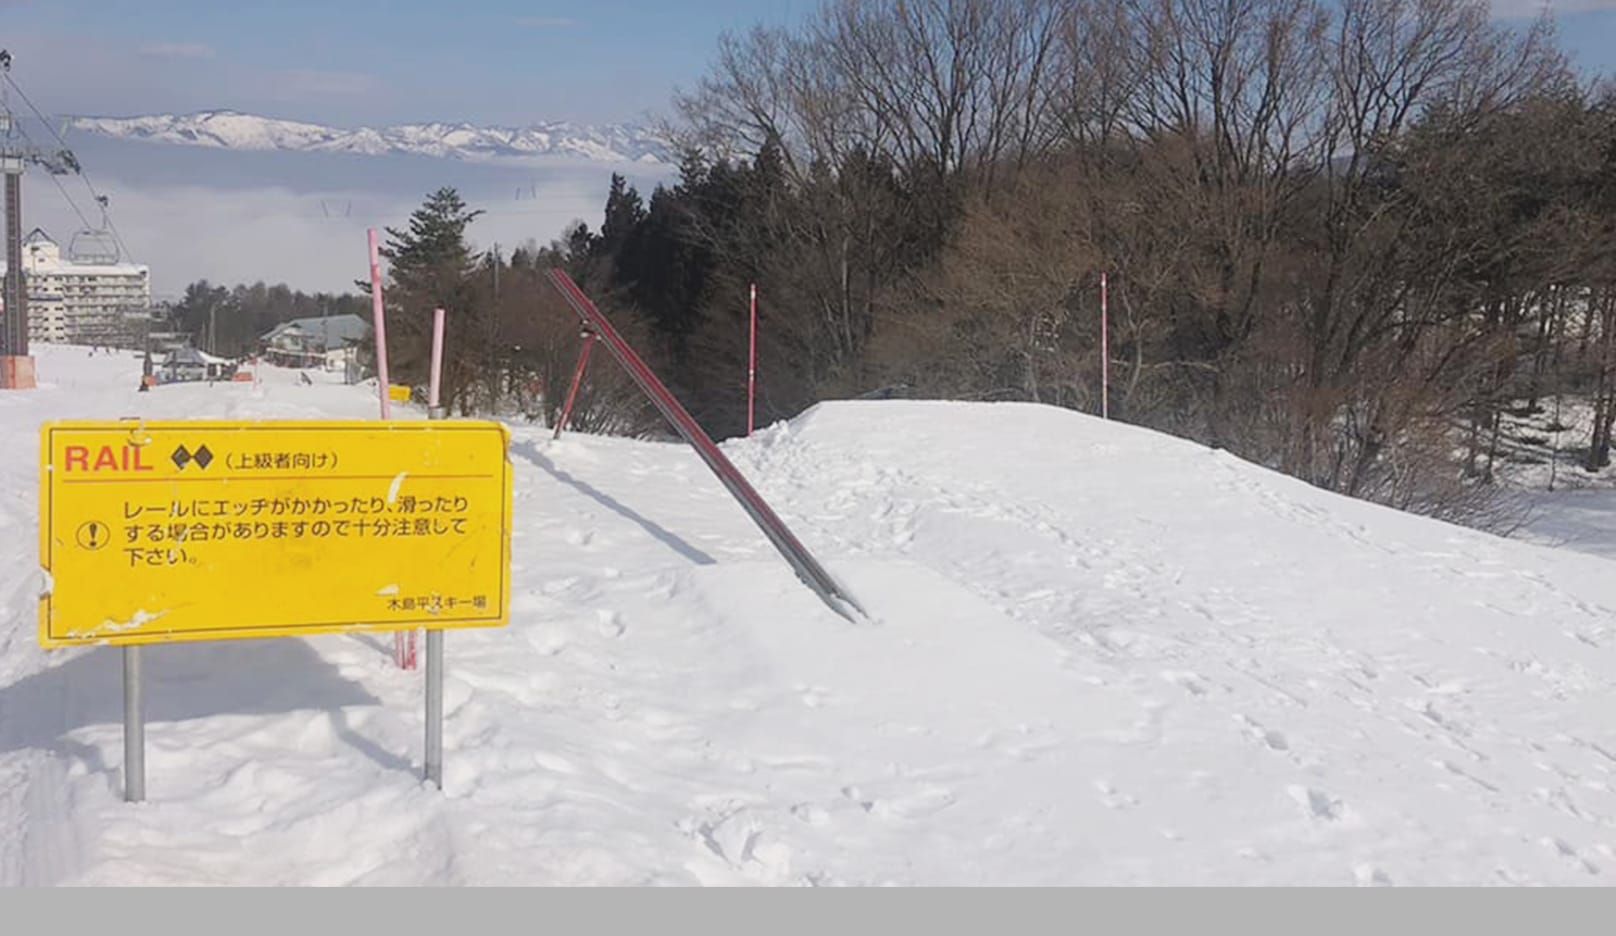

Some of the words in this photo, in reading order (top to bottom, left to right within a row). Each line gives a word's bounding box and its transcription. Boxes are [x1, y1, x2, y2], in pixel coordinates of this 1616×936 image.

[65, 445, 153, 472] RAIL
[225, 452, 339, 471] （上級者向け）
[125, 517, 468, 542] する場合がありますので十分注意して
[124, 547, 197, 567] 下さい。
